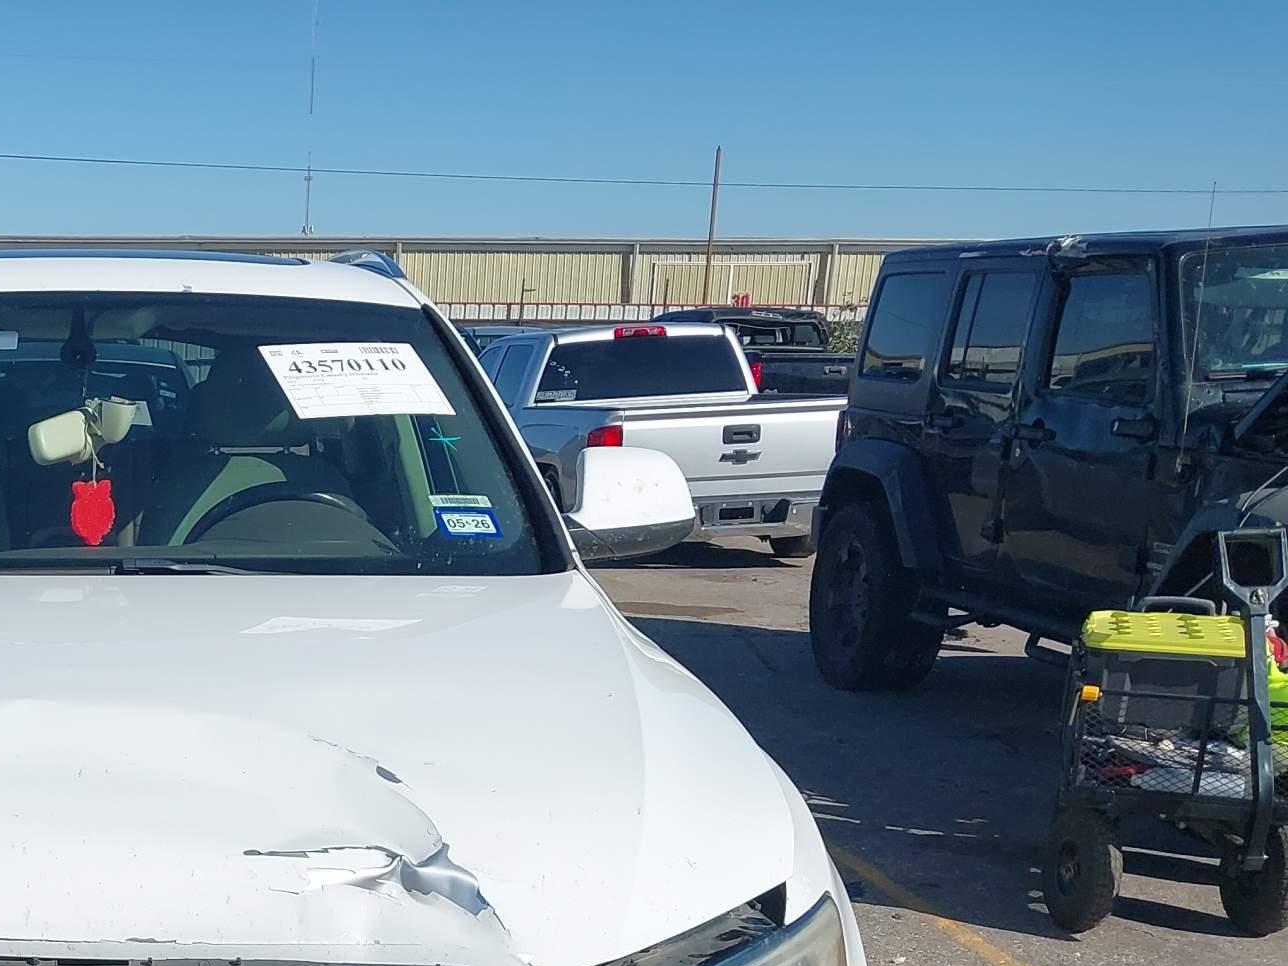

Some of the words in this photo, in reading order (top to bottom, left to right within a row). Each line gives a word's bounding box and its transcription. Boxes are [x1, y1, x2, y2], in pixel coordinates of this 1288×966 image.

[288, 358, 407, 374] 43570110
[447, 518, 466, 528] 05
[471, 519, 490, 529] 26
